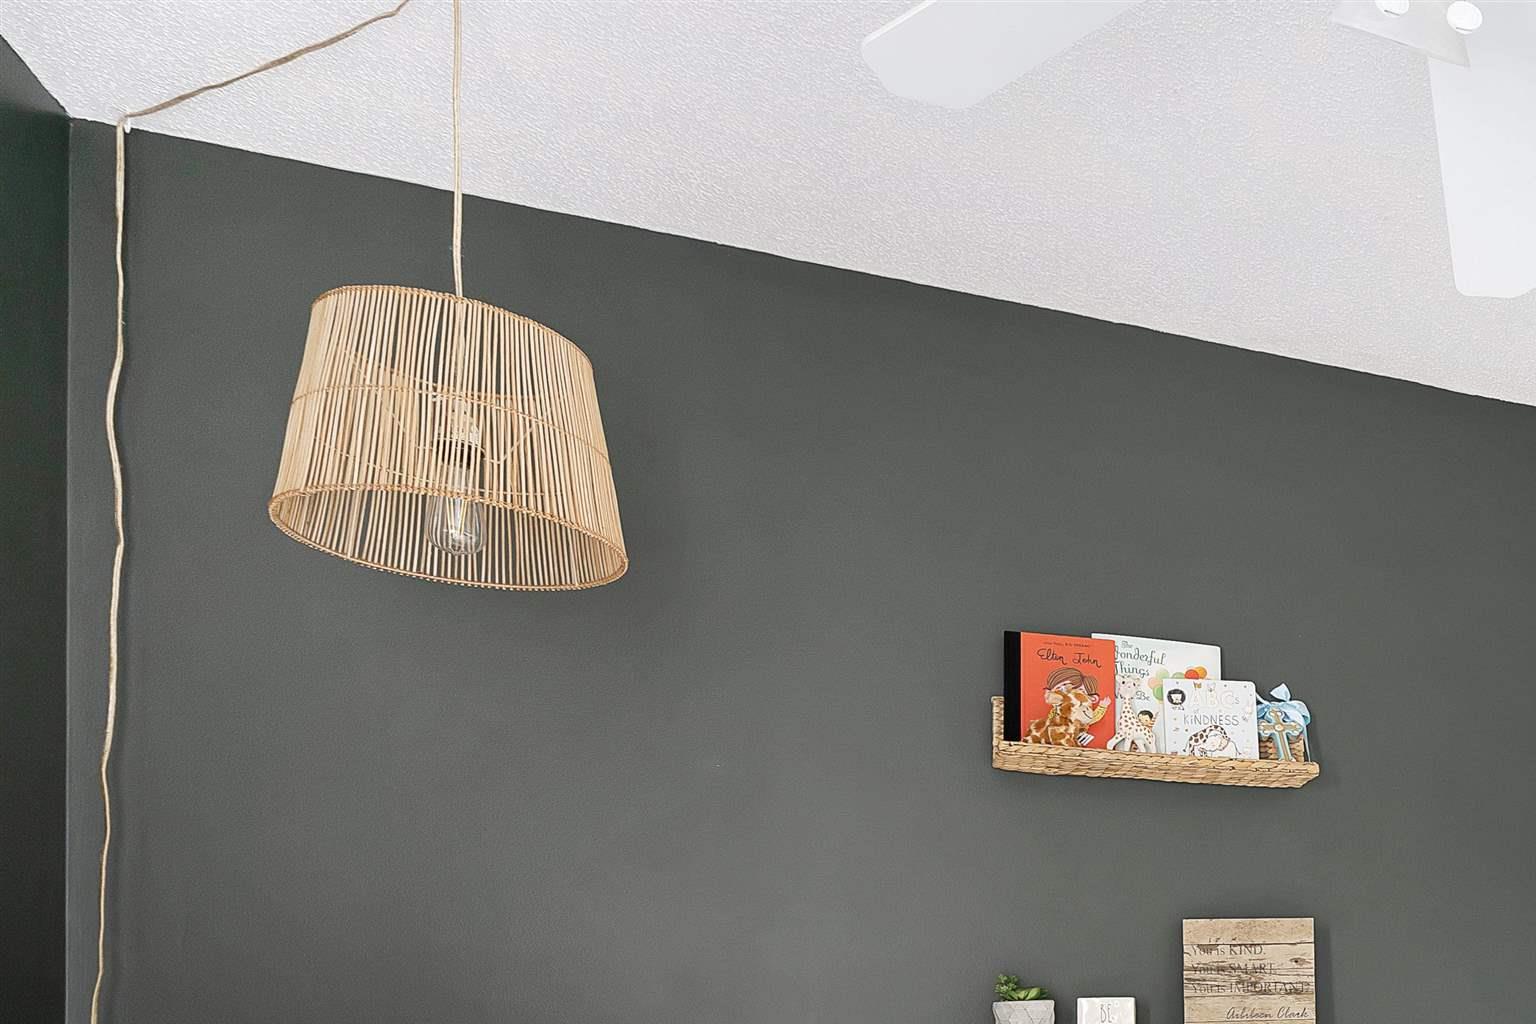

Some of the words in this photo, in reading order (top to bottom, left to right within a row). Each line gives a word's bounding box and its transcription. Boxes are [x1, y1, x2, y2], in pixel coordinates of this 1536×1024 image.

[1037, 648, 1068, 666] Elton
[1072, 652, 1102, 668] John
[1100, 1003, 1112, 1023] BE
[1277, 1006, 1310, 1019] Clark
